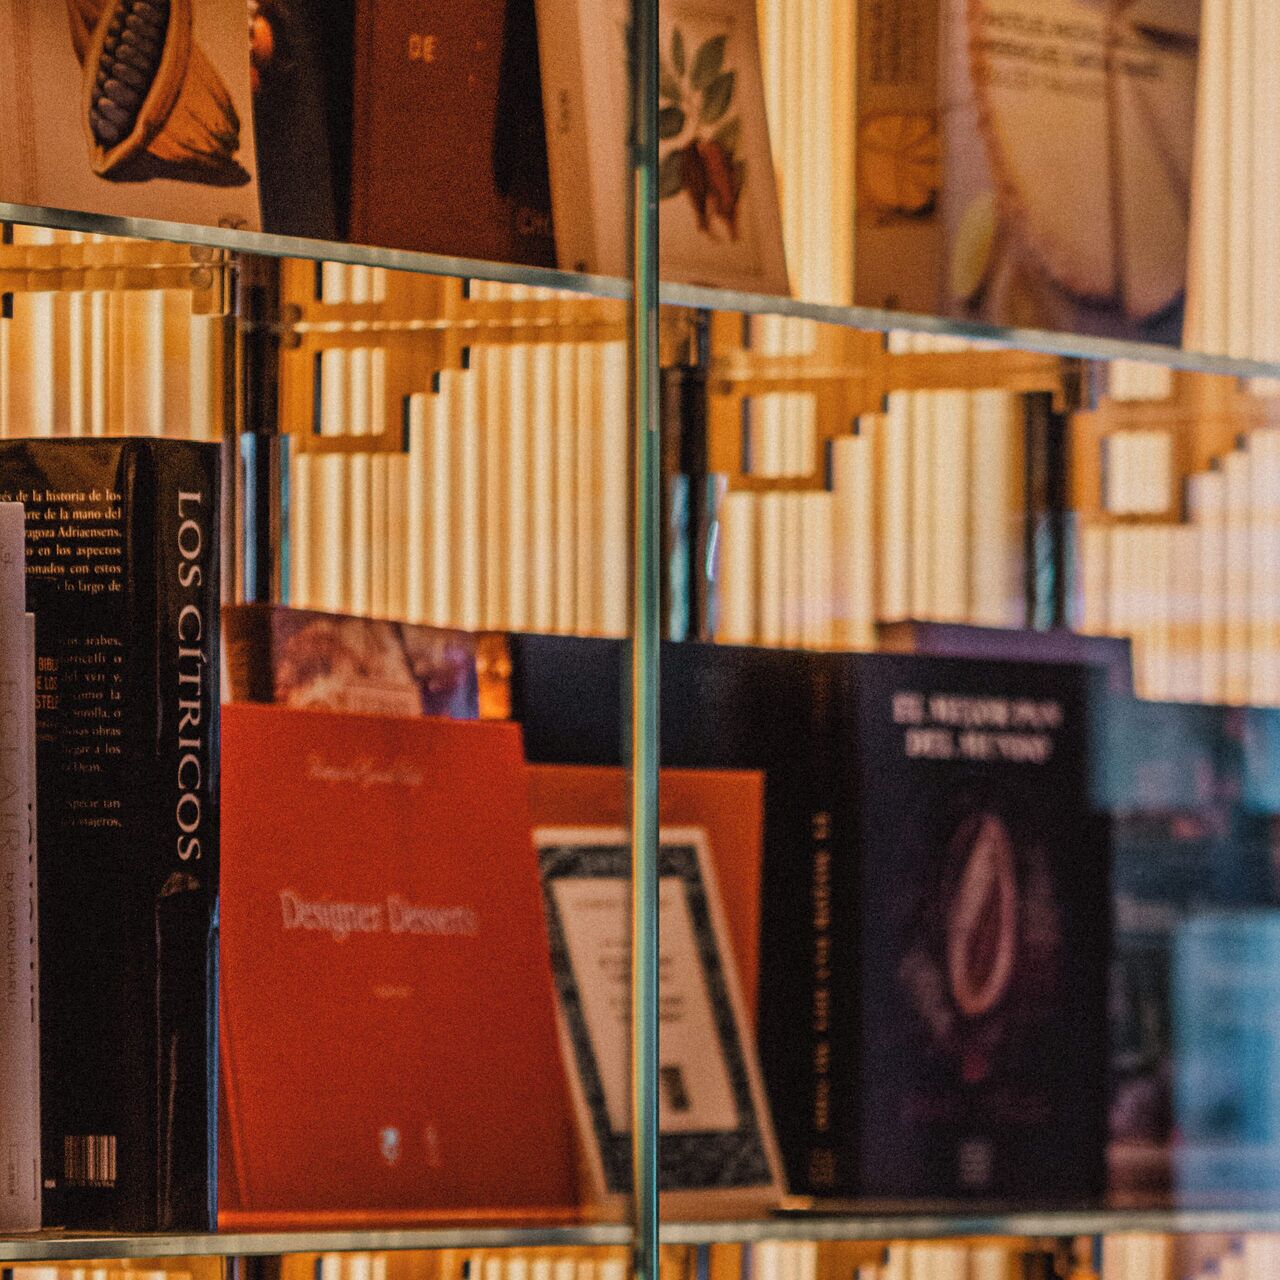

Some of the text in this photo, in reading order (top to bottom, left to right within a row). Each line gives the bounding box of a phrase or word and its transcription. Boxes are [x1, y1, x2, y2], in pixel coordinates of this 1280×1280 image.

[32, 489, 42, 502] la
[46, 489, 85, 502] historia
[89, 488, 101, 502] de
[105, 488, 122, 502] los
[25, 507, 122, 520] rte de la mano del
[38, 547, 51, 557] en
[56, 544, 72, 557] los
[76, 547, 122, 560] aspectos
[70, 565, 89, 575] con
[94, 565, 122, 575] estos
[78, 580, 104, 595] largo
[107, 580, 122, 592] de
[176, 490, 208, 862] LOS CÍTRICOS
[110, 689, 121, 701] la
[280, 889, 480, 943] Designer Desserts
